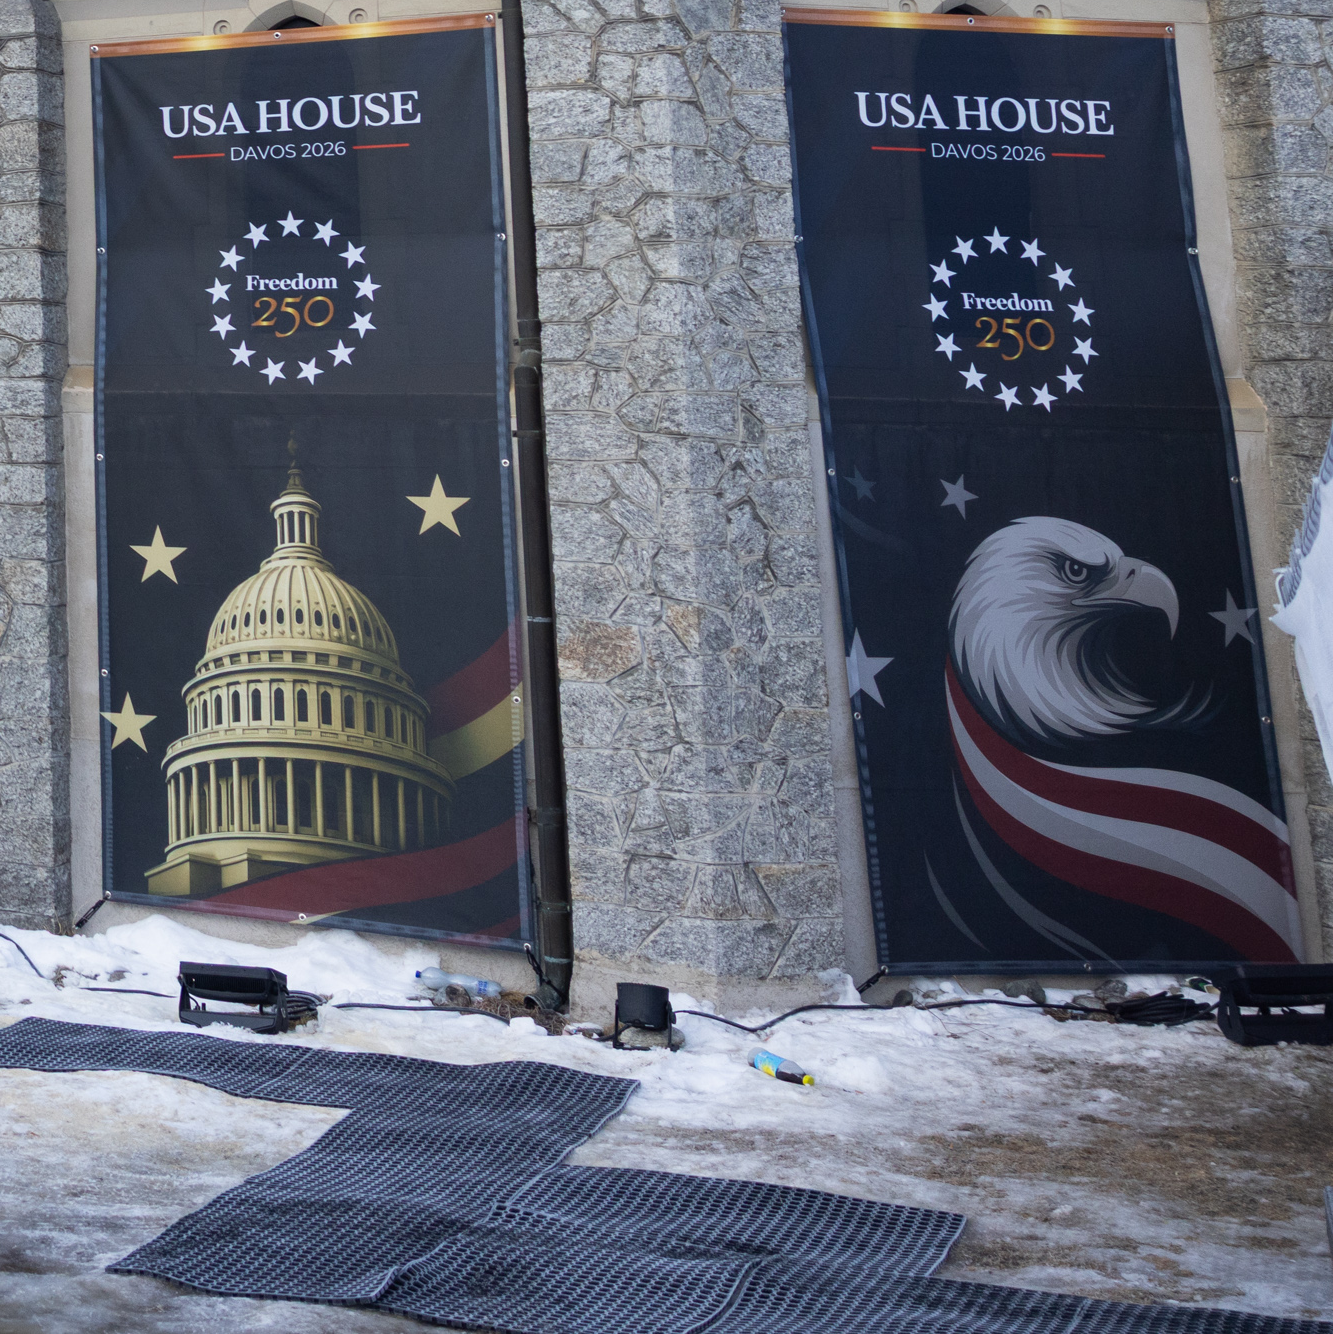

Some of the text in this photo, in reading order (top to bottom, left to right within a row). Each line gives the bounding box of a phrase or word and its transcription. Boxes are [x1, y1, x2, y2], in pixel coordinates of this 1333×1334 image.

[159, 90, 422, 139] USA HOUSE
[854, 91, 1114, 136] USA HOUSE
[230, 141, 346, 161] DAVOS 2026
[931, 142, 1046, 162] DAVOS 2026
[245, 272, 338, 291] Freedom
[251, 295, 335, 338] 250
[960, 292, 1054, 312] Freedom
[975, 316, 1055, 361] 250
